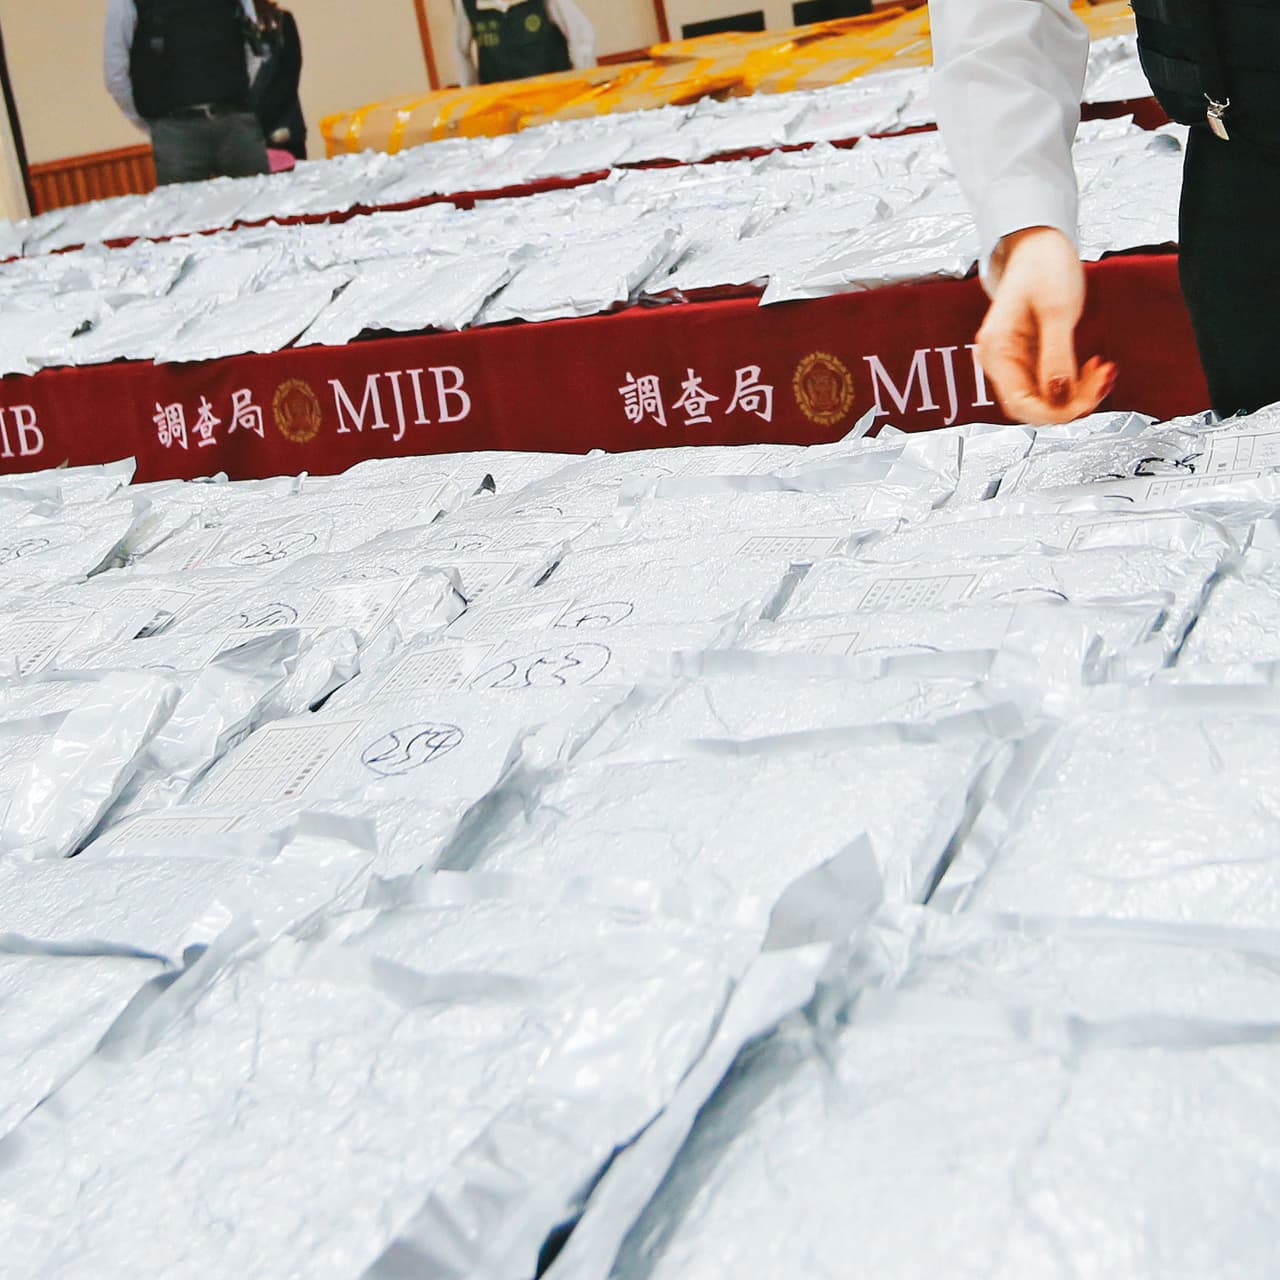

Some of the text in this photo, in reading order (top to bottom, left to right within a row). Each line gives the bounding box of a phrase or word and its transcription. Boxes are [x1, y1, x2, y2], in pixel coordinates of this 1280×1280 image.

[152, 365, 472, 450] 調查局 MJIB
[618, 342, 995, 427] 調查局 MJI
[364, 726, 460, 769] 254
